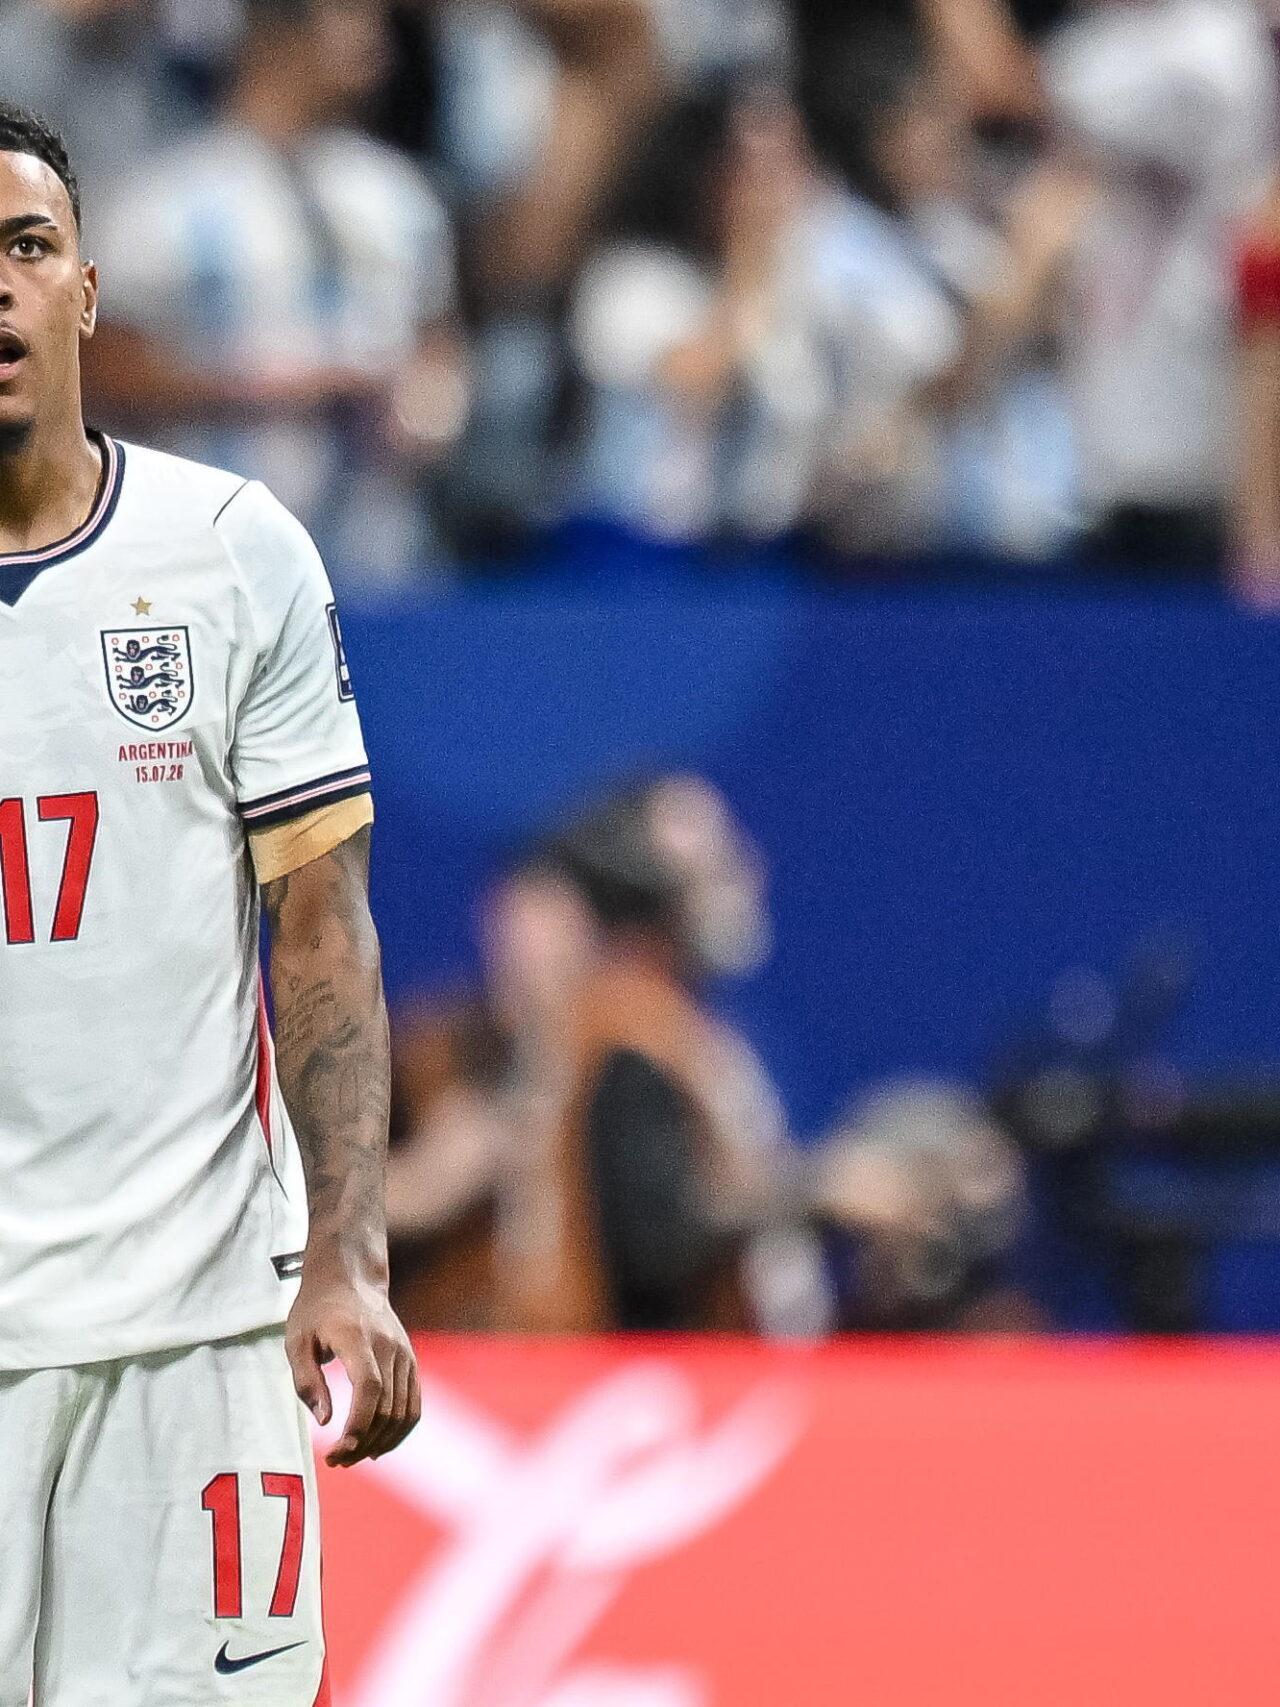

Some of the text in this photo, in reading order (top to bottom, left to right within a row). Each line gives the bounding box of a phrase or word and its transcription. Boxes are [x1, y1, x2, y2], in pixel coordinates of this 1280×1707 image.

[118, 740, 193, 761] ARGENTINA
[136, 764, 184, 783] 15.07.26
[201, 1471, 306, 1619] 17
